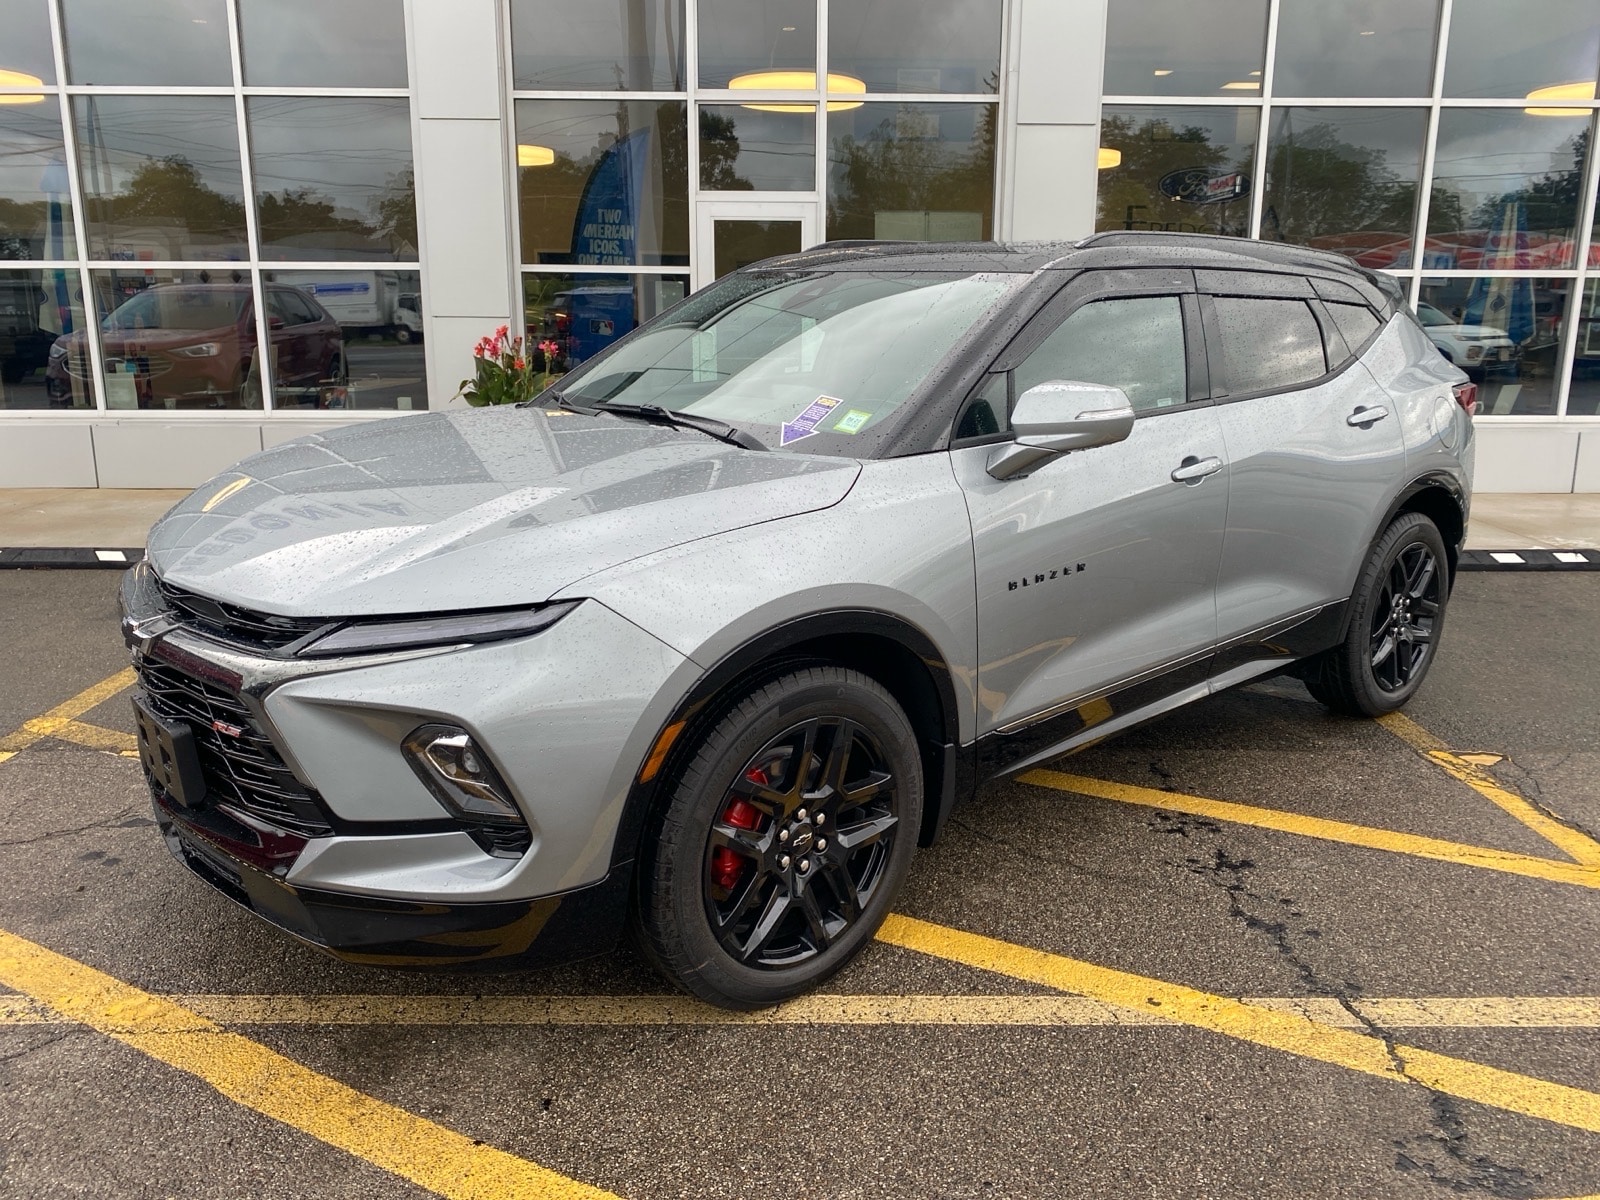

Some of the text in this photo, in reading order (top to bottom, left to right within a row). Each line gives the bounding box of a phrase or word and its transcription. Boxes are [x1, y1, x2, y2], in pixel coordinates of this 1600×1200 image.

[597, 208, 622, 224] TWO
[583, 223, 635, 241] AMERICAN
[578, 253, 600, 265] ONE
[1008, 562, 1087, 591] BLAZER
